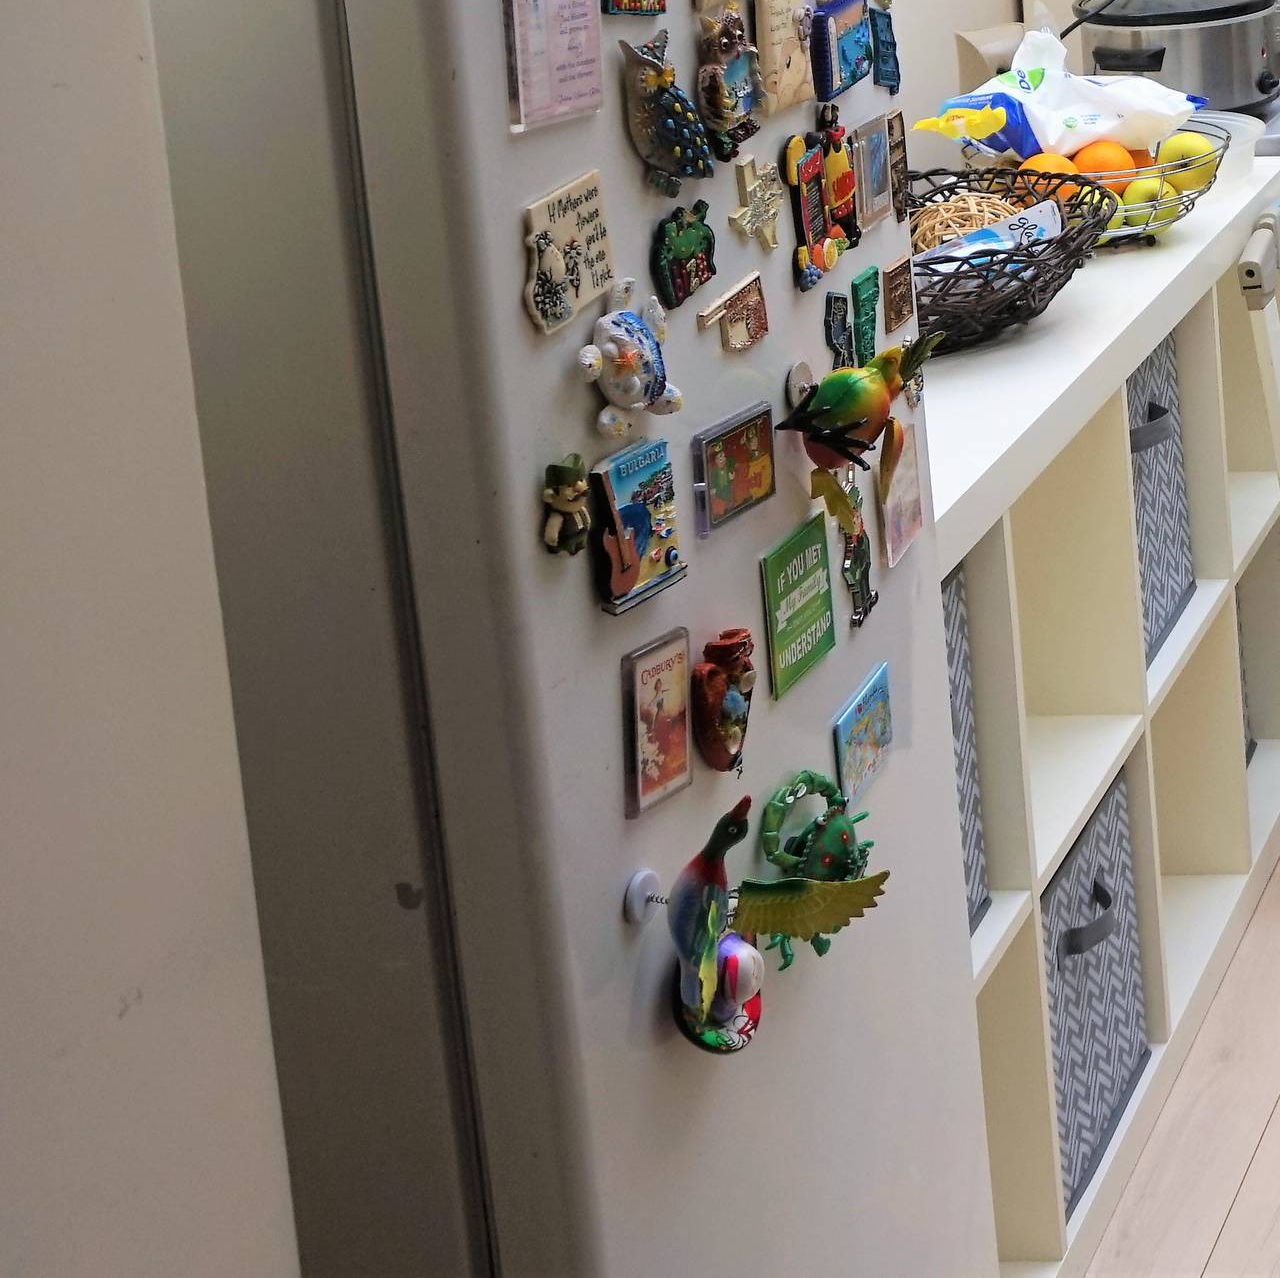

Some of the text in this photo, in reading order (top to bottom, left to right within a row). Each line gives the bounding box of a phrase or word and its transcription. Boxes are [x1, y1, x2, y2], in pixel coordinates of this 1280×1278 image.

[557, 193, 583, 218] Mothers
[777, 543, 822, 594] IF YOU MET
[779, 611, 833, 669] UNDERSTAND
